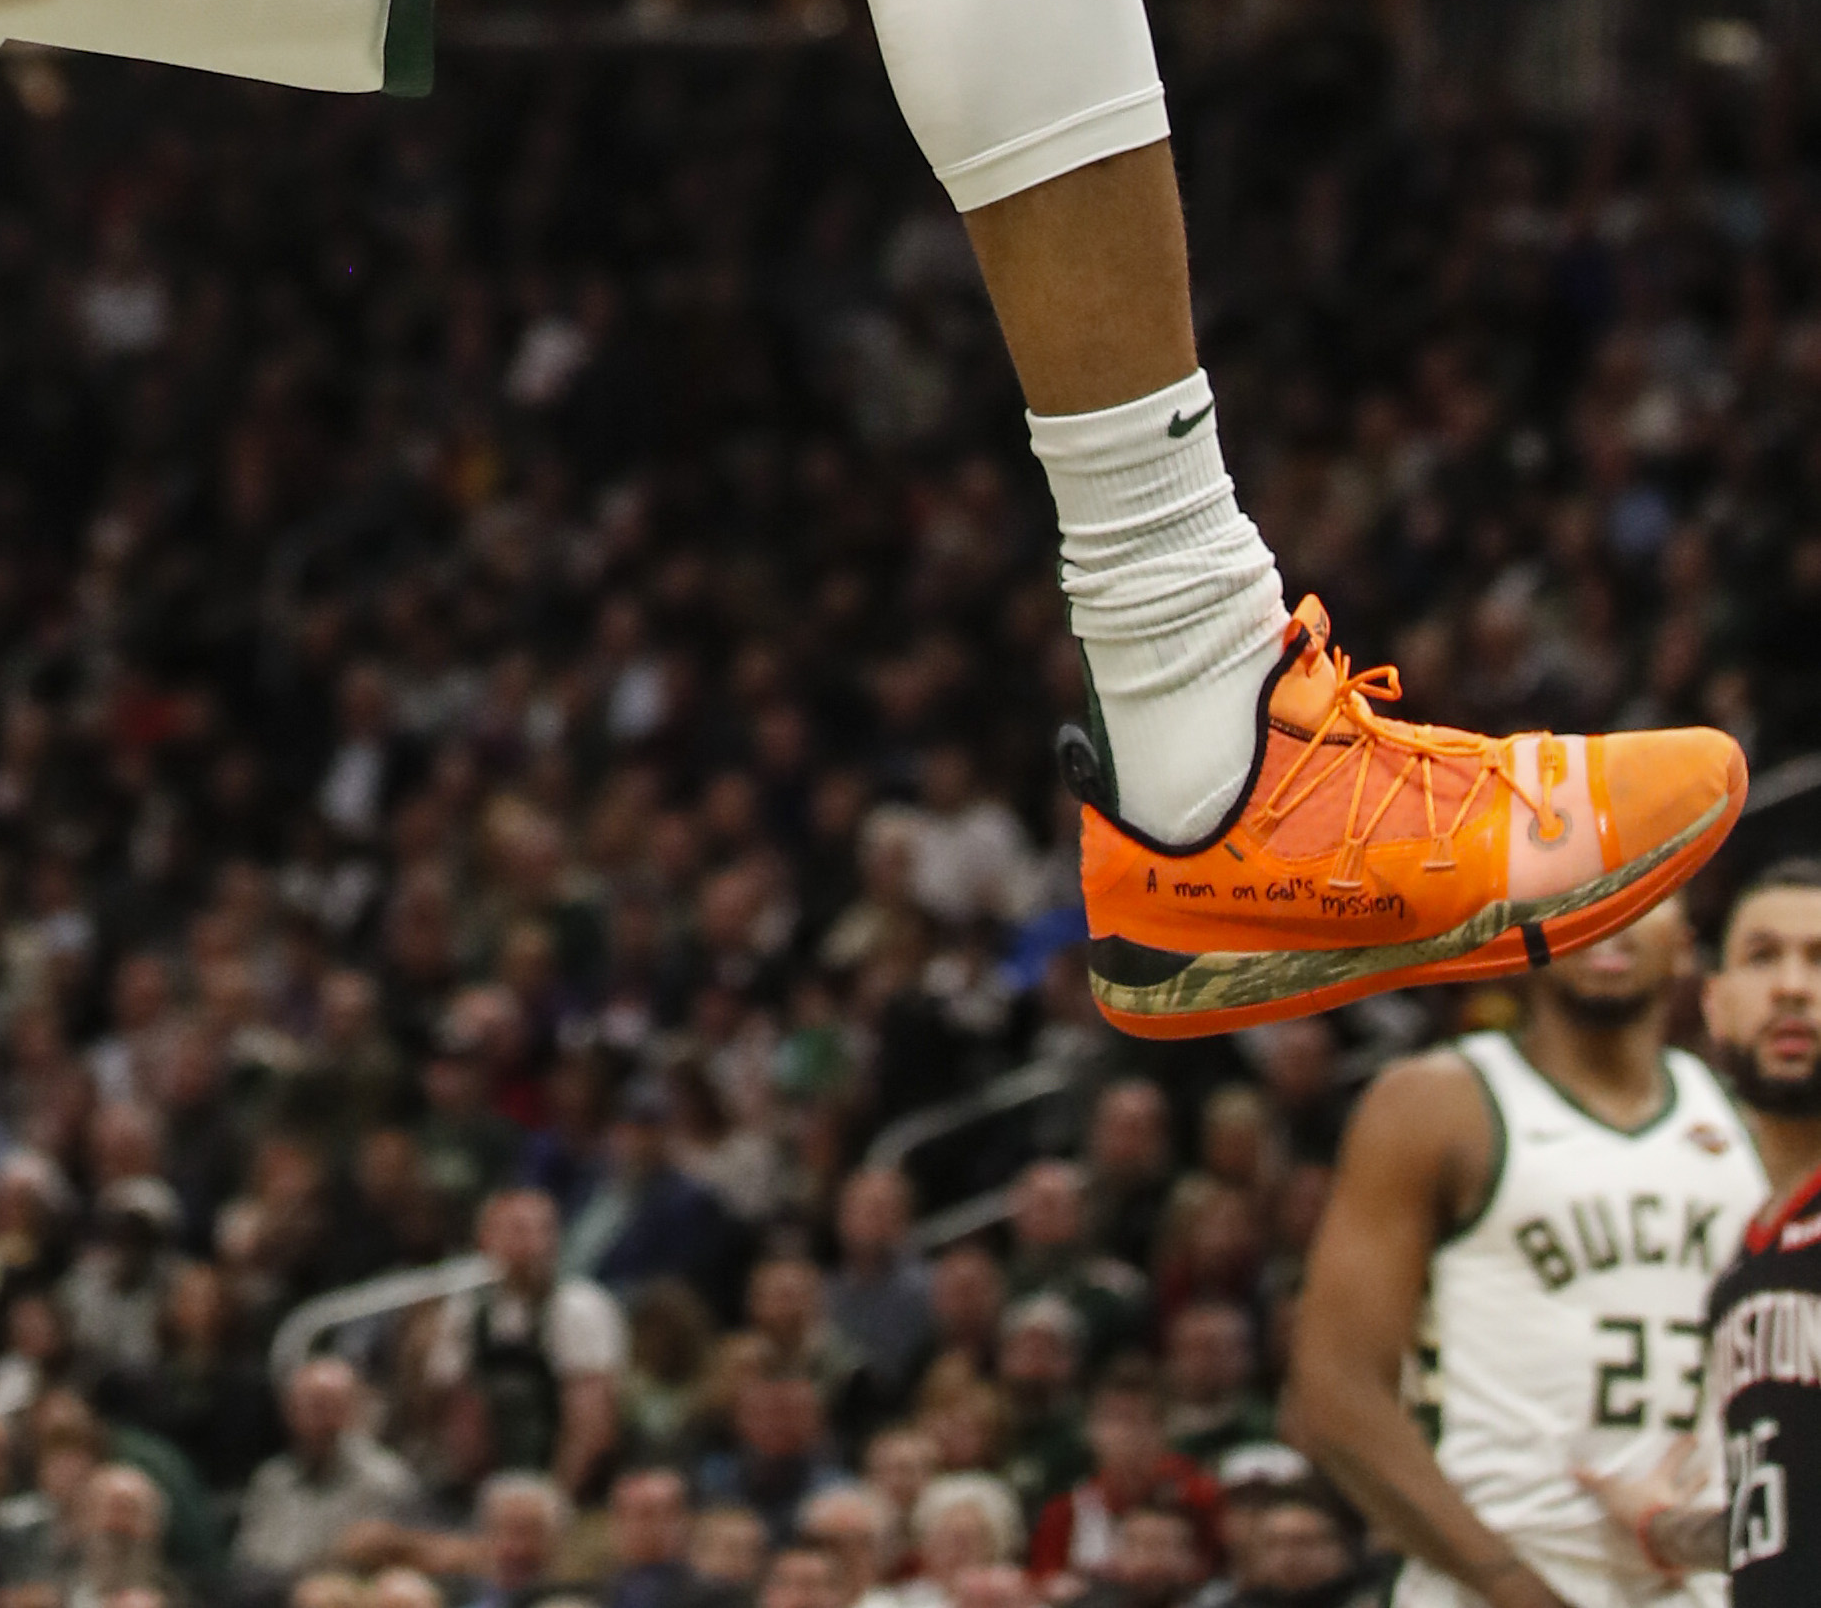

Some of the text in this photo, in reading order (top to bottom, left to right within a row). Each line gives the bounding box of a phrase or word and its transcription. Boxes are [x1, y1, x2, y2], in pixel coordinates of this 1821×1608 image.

[1146, 867, 1157, 894] A
[1174, 883, 1217, 898] man
[1232, 885, 1258, 902] on
[1321, 892, 1405, 920] mission
[1513, 1191, 1720, 1293] BUCK
[1591, 1314, 1707, 1431] 23
